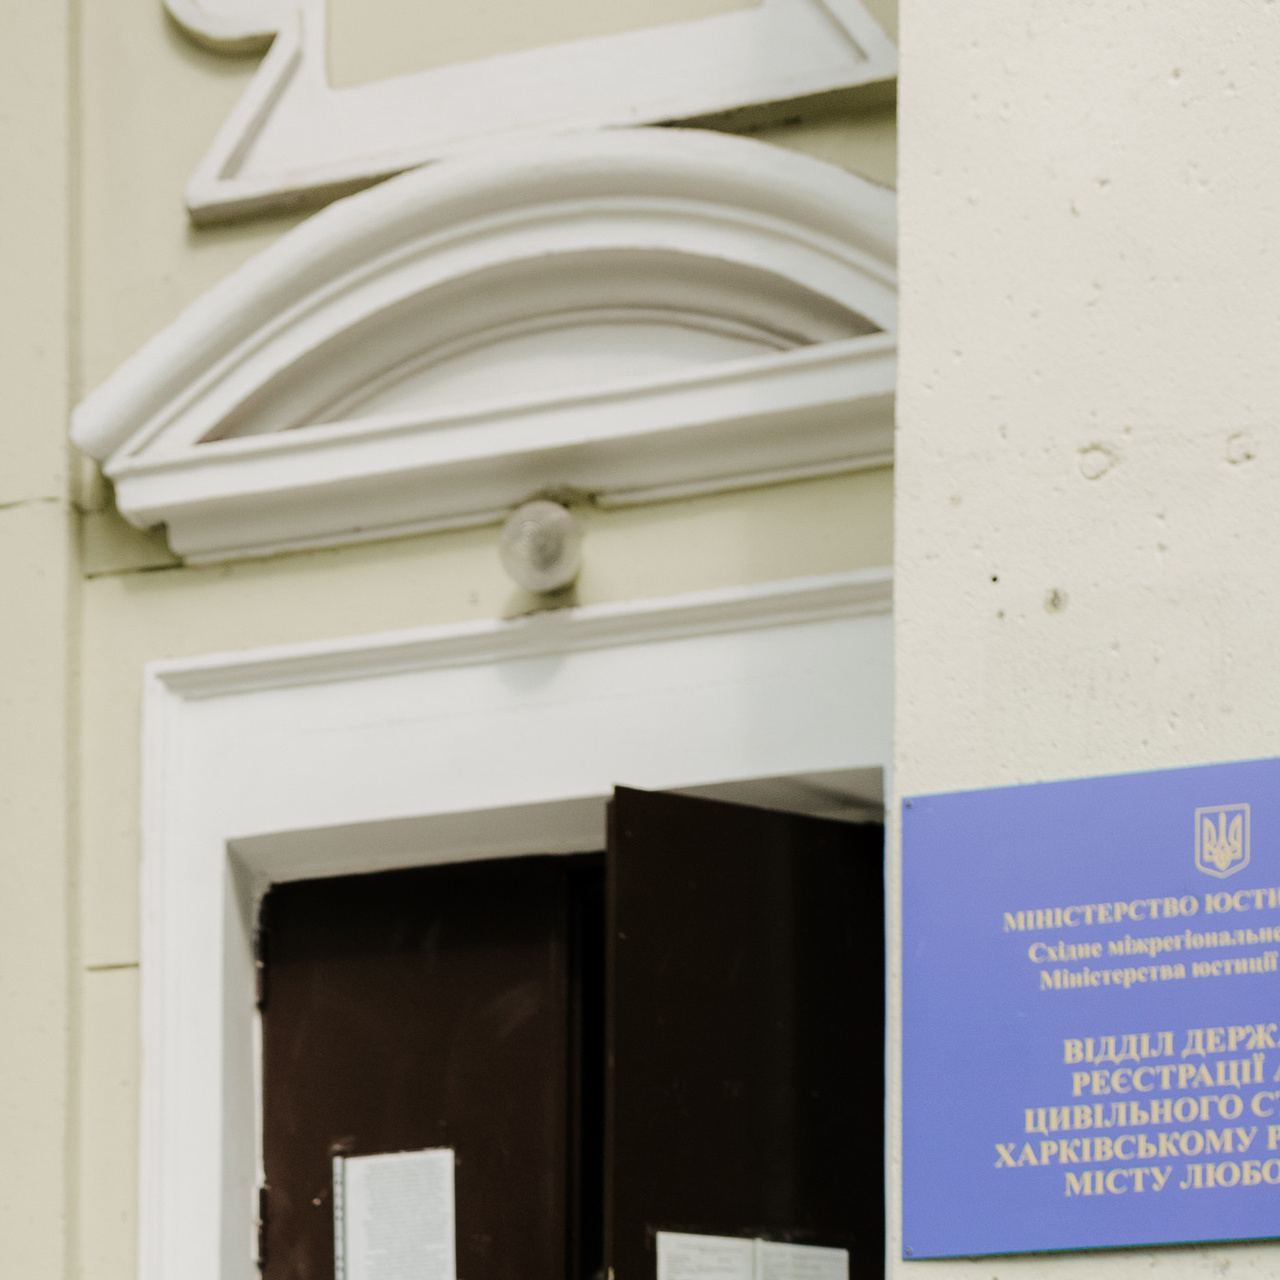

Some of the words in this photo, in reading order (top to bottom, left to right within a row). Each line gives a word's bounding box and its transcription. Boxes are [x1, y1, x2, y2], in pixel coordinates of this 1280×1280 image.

[1004, 896, 1199, 931] МІНІСТЕРСТВО
[1028, 941, 1102, 962] Східне
[1041, 964, 1185, 990] Міністерства
[1192, 951, 1278, 977] юстиції
[1064, 1032, 1173, 1065] ВІДДІЛ
[1182, 1023, 1280, 1058] ДЕРЖ
[1073, 1053, 1265, 1096] РЕЄСТРАЦІЇ
[1025, 1094, 1243, 1135] ЦИВІЛЬНОГО
[1251, 1091, 1280, 1117] С
[995, 1127, 1257, 1168] ХАРКІВСЬКОМУ
[1065, 1166, 1172, 1196] МІСТУ
